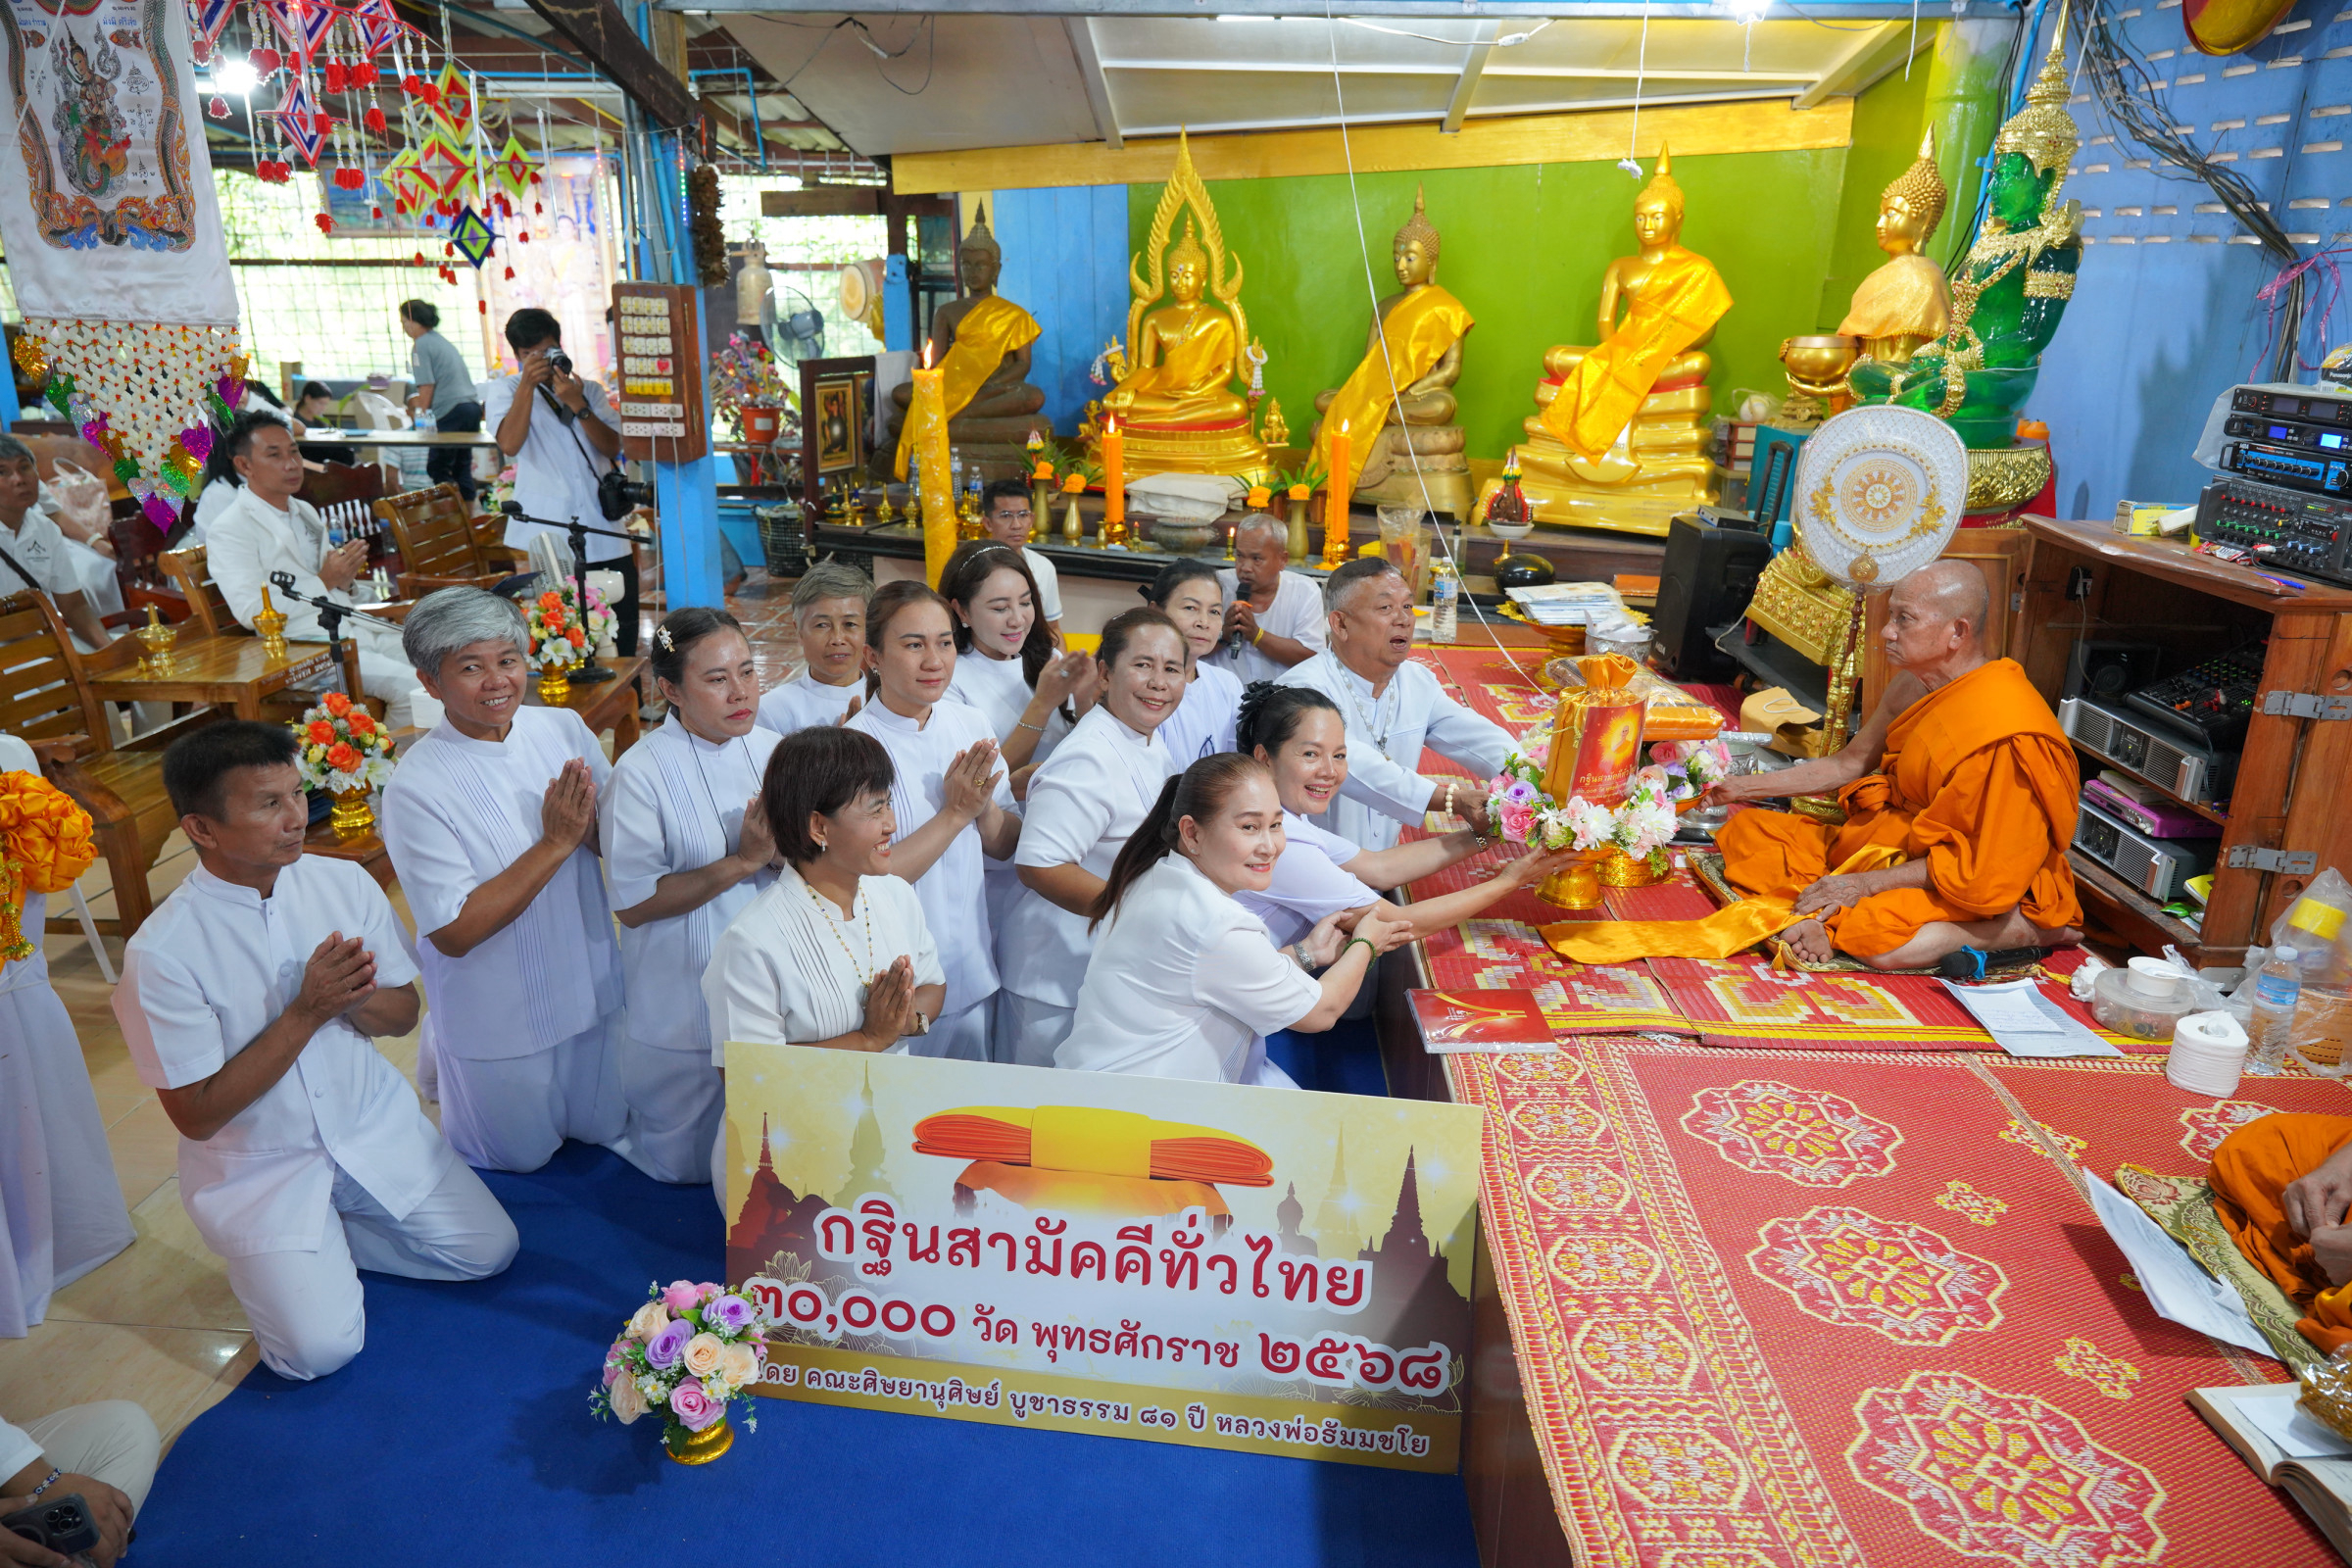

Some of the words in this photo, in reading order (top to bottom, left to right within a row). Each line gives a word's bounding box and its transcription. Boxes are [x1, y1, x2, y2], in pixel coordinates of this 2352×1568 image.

[820, 1200, 1364, 1307] กฐินสามัคคีทั่วไทย
[752, 1284, 956, 1338] ๓๐,๐๐๐
[972, 1303, 1017, 1345] วัด
[1031, 1319, 1240, 1368] พุทธศักราช
[1257, 1333, 1443, 1390] ๒๕๖๘
[808, 1369, 1000, 1409] คณะศิษยานุศิษย์
[1009, 1393, 1129, 1421] บูชาธรรม
[1140, 1407, 1176, 1428] ๘๑
[1188, 1404, 1205, 1430] ปี
[1216, 1416, 1427, 1454] หลวงพ่อธัมมชโย
